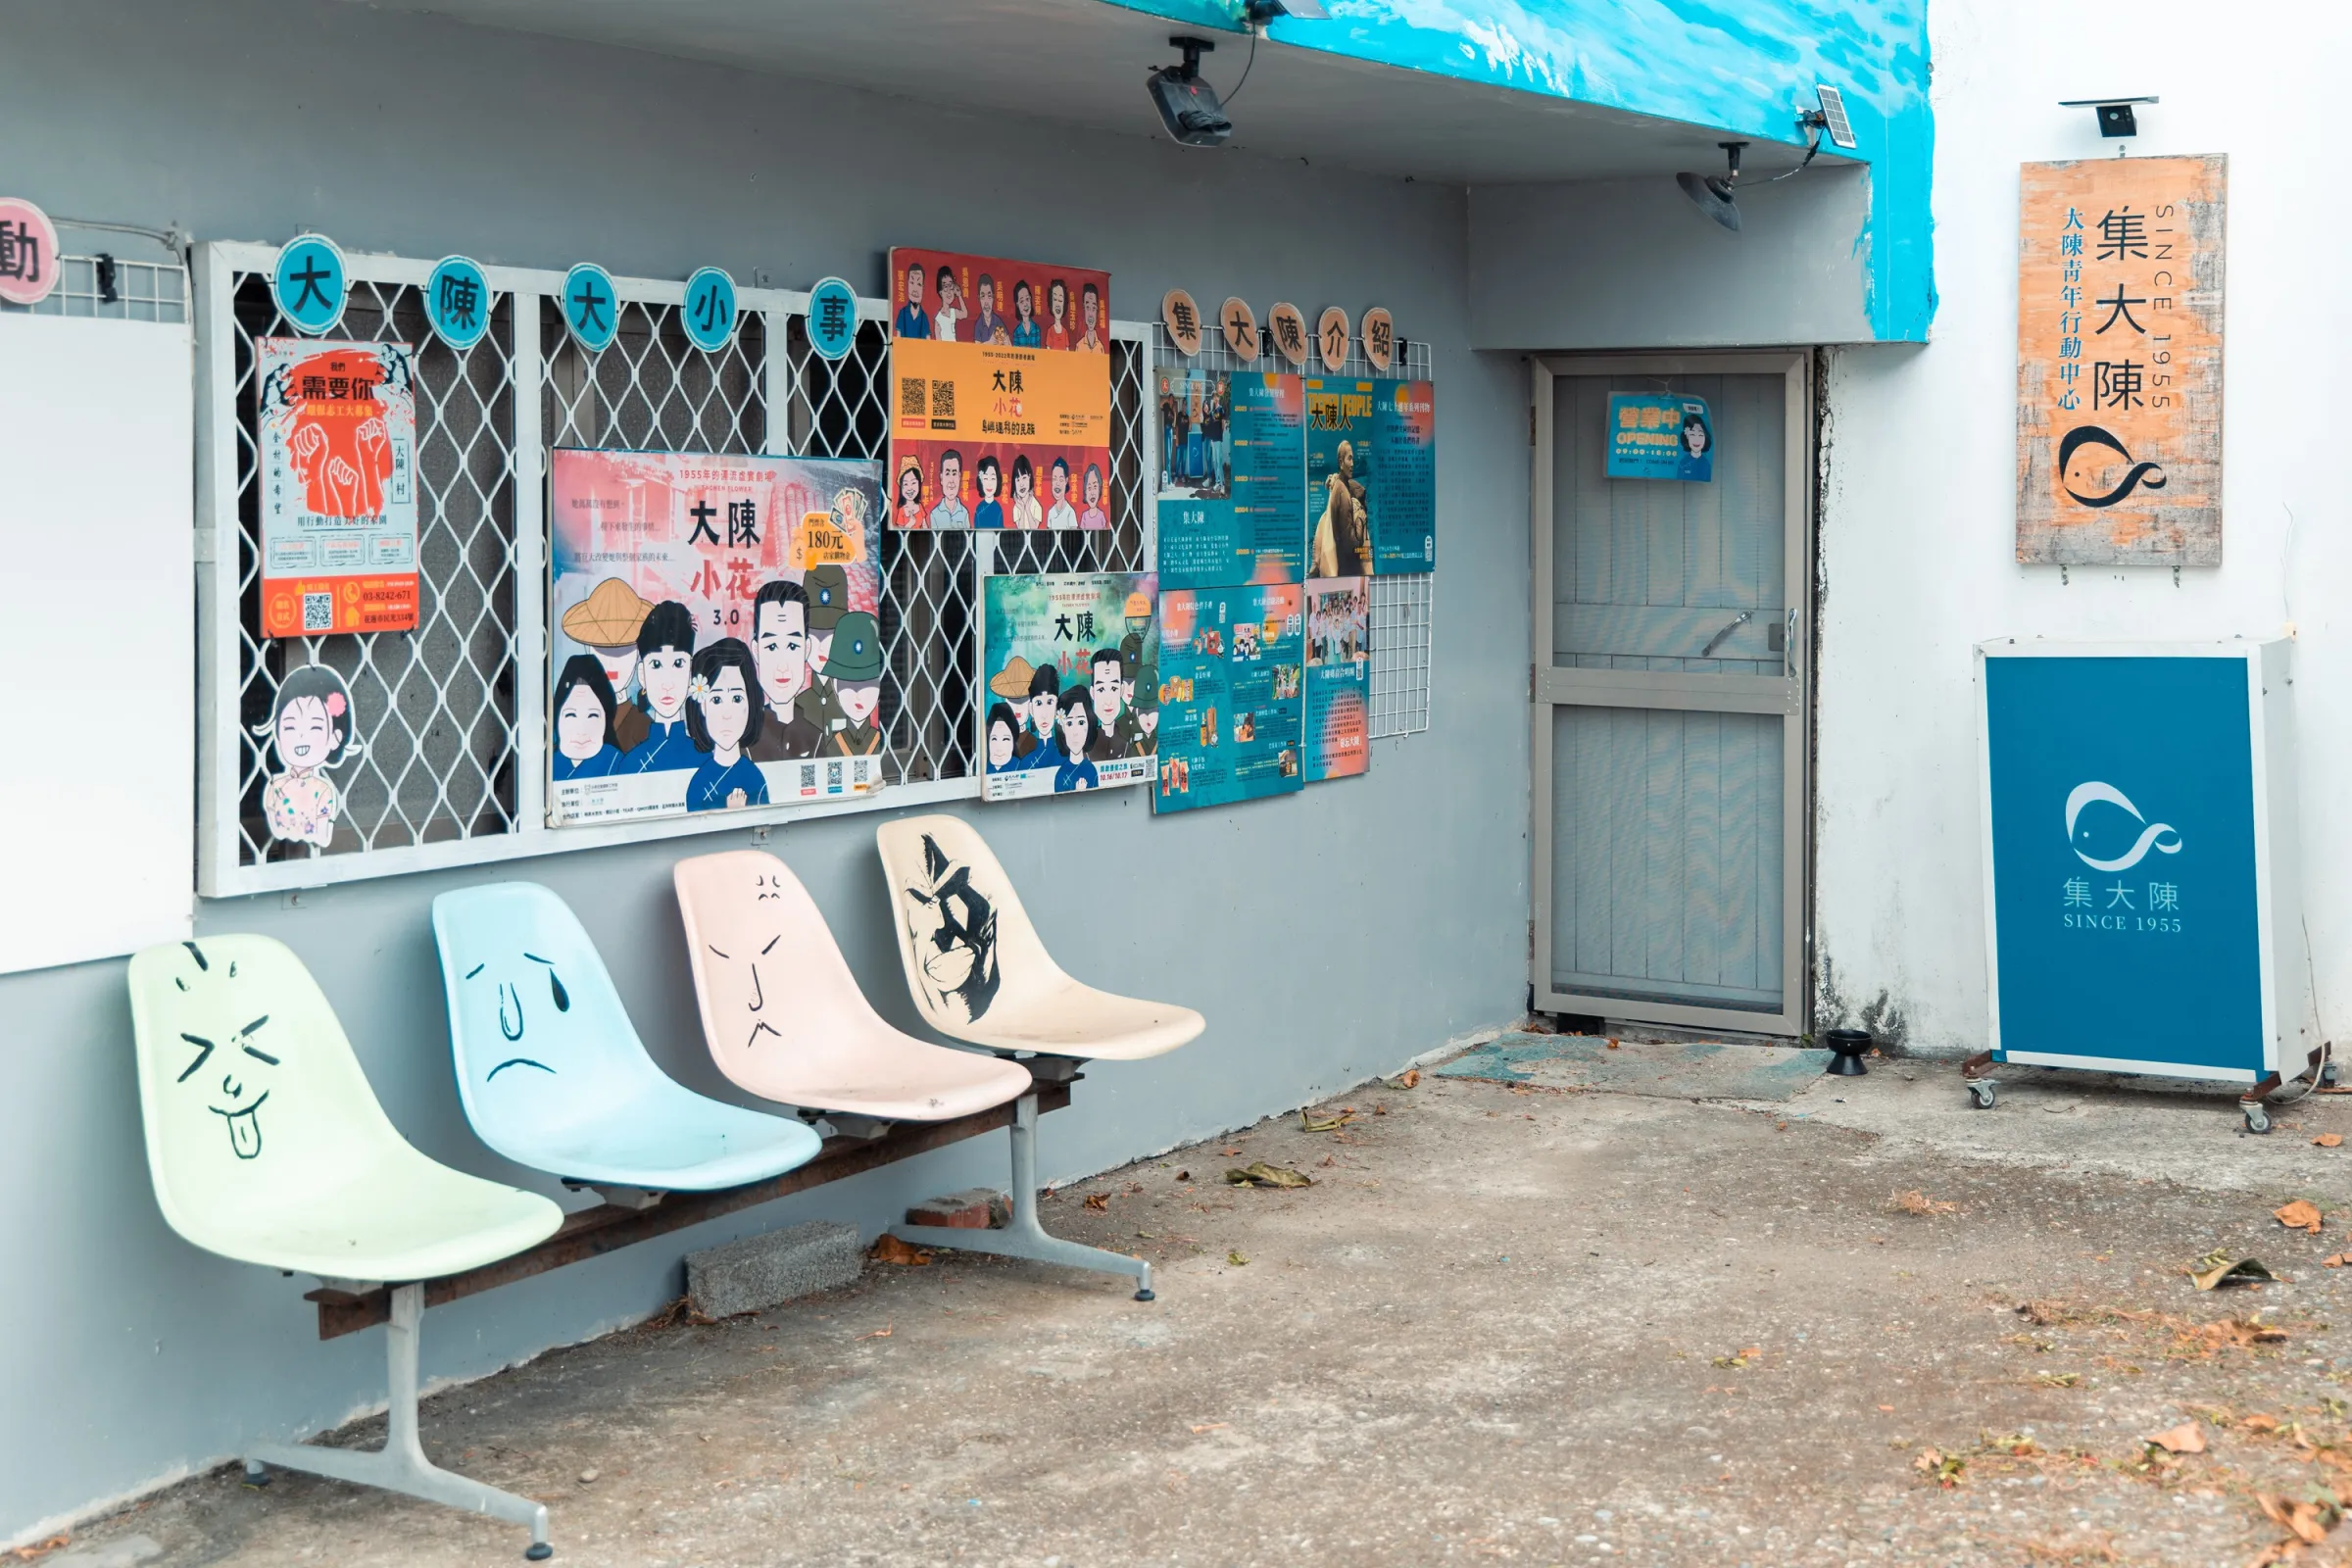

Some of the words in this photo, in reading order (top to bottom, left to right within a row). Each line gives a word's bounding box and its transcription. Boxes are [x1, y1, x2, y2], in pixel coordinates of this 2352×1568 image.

[2153, 204, 2174, 311] SINCE
[290, 256, 332, 314] 大
[439, 274, 479, 331] 陳
[573, 282, 607, 333] 大
[694, 285, 727, 332] 小
[819, 295, 849, 342] 事
[2057, 207, 2084, 412] 大陳青年行動中心
[2093, 205, 2149, 412] 集大陳
[330, 362, 346, 372] 我們
[2151, 334, 2171, 409] 1955
[302, 375, 375, 400] 需要你
[992, 369, 1023, 394] 大陳
[993, 397, 1022, 417] 小花
[1311, 403, 1352, 430] 大陳人
[1619, 407, 1681, 429] 營業中
[1616, 432, 1679, 446] OPENING
[395, 446, 405, 495] 大陳一村
[687, 499, 760, 549] 大陳
[1183, 511, 1204, 524] 集大陳
[808, 531, 844, 549] 180元
[690, 557, 758, 601] 小花
[363, 590, 412, 601] 03-8242-671
[712, 610, 740, 625] 3.0
[1054, 611, 1096, 642] 大陳
[1057, 648, 1093, 676] 小花
[2063, 876, 2180, 911] 集大陳
[2064, 912, 2127, 930] SINCE
[2136, 916, 2181, 933] 1955
